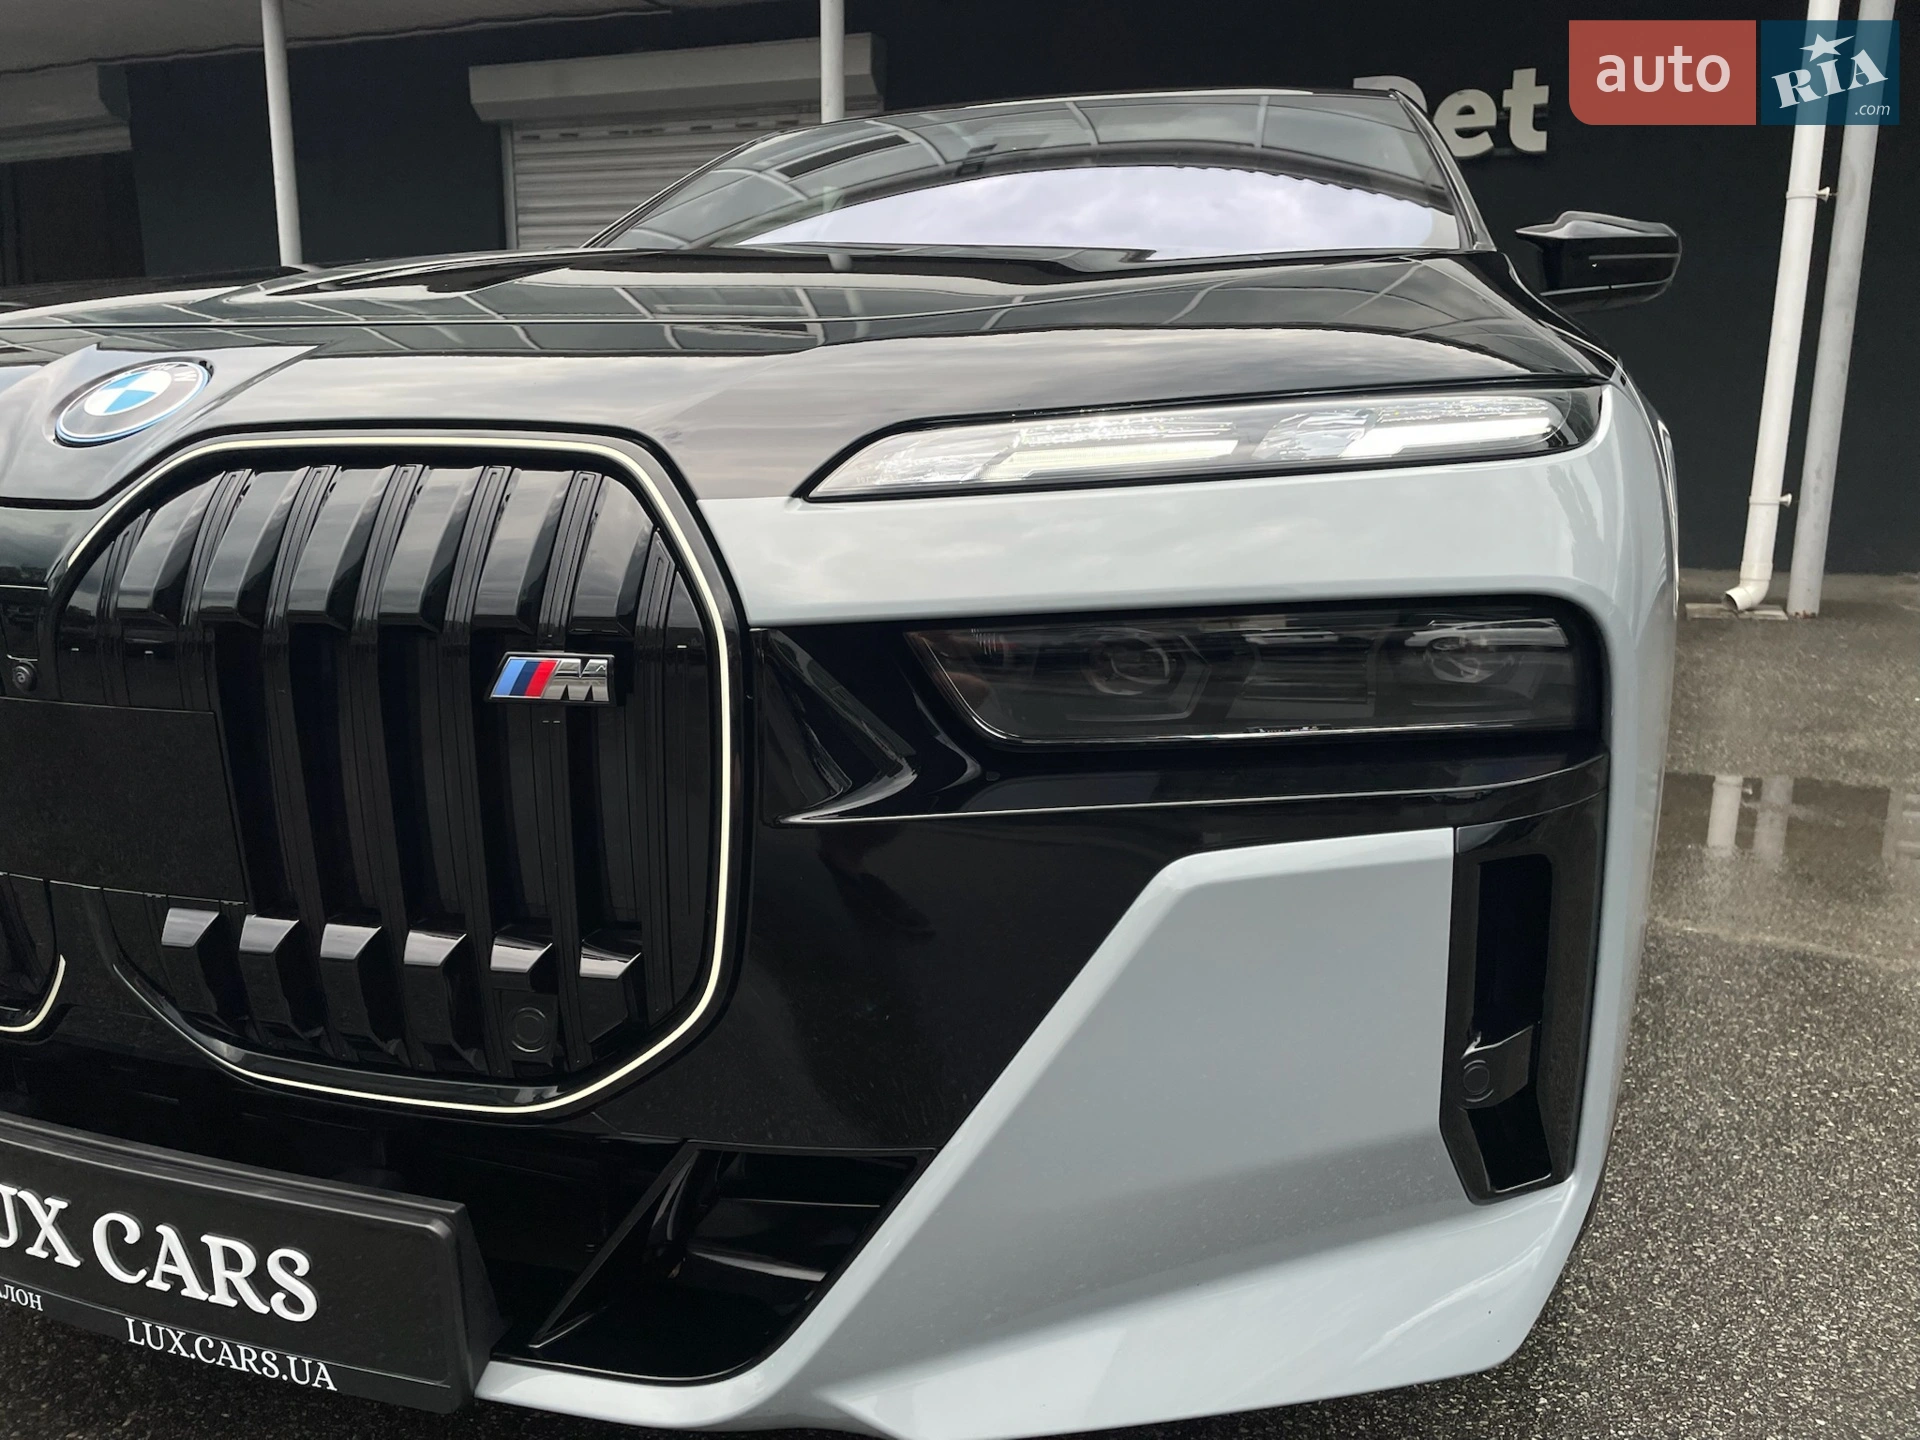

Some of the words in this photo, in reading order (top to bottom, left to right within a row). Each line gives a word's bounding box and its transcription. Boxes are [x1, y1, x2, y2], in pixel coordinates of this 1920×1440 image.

[0, 1284, 43, 1312] ЛОН
[92, 1211, 318, 1322] CARS
[125, 1317, 338, 1392] LUX.CARS.UA
